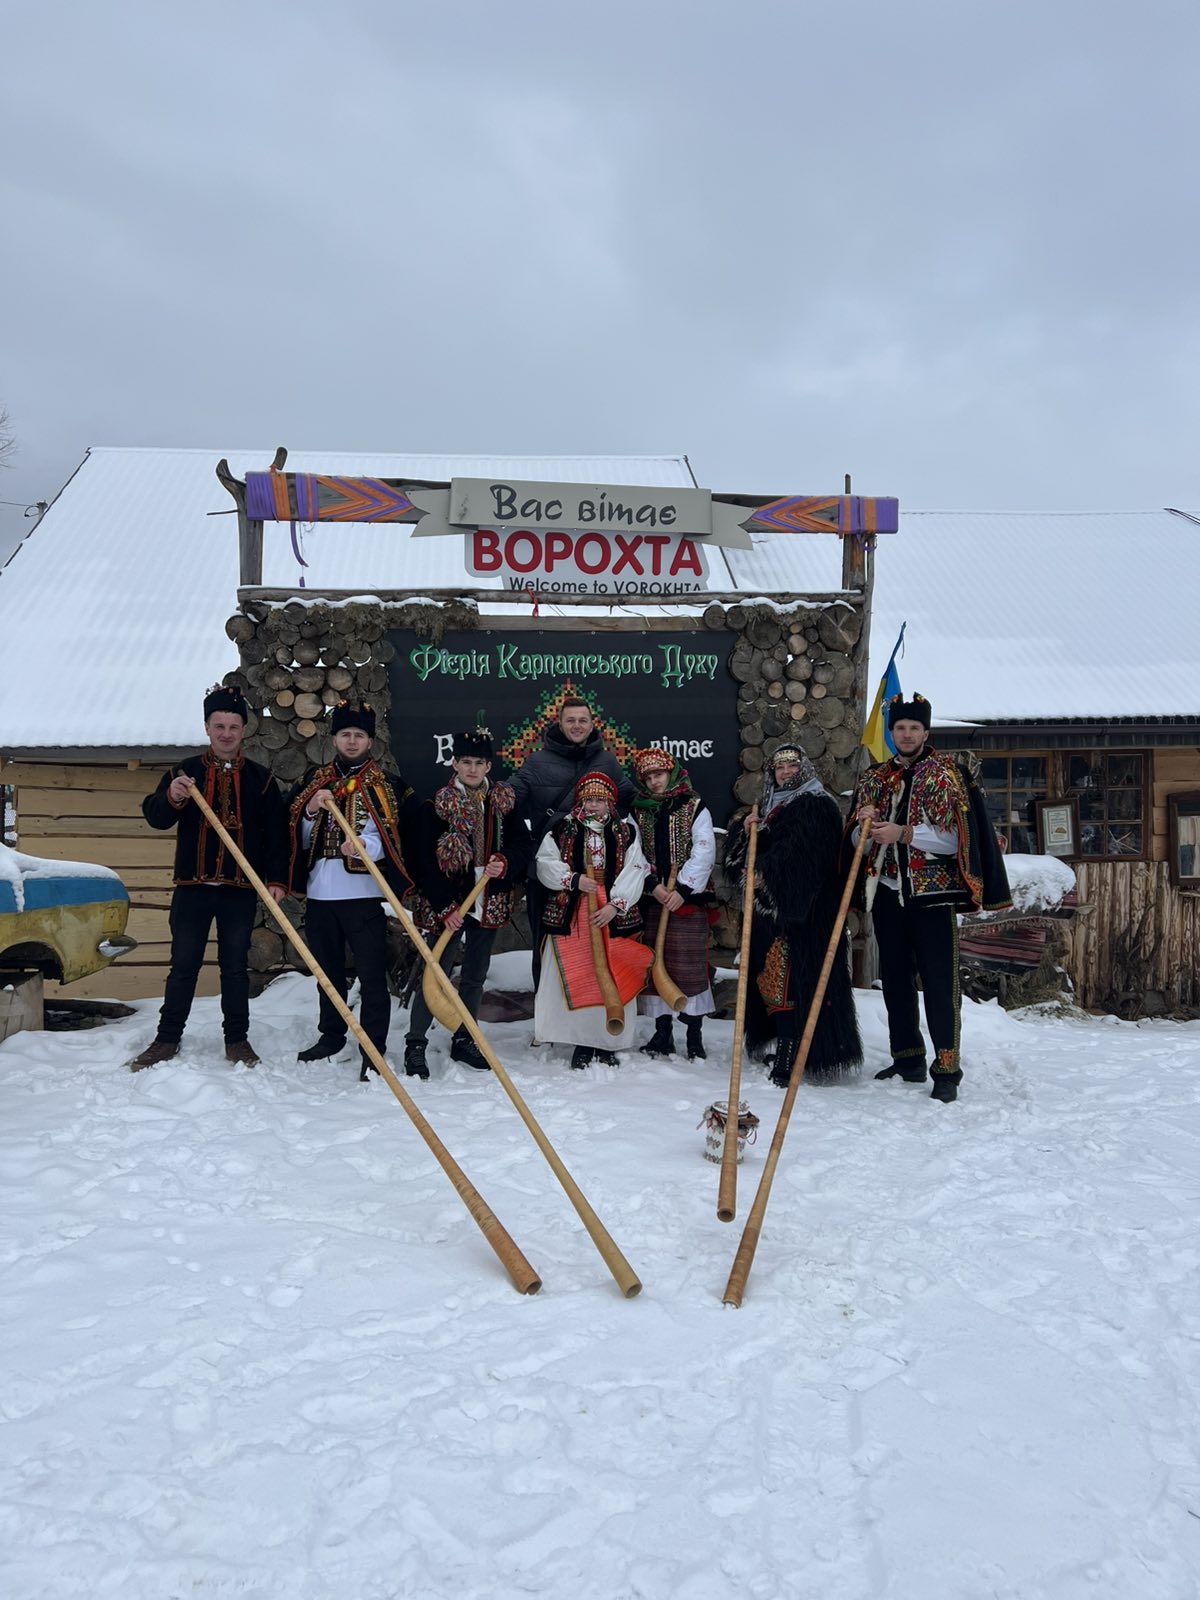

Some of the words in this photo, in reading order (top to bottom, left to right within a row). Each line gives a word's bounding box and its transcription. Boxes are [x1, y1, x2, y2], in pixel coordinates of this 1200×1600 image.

[489, 484, 563, 521] Вас
[578, 492, 677, 526] вітає
[472, 530, 703, 577] ВОРОХТА
[509, 577, 588, 594] Welcome
[593, 581, 608, 594] to
[614, 580, 701, 595] VOROKHTA
[409, 643, 491, 681] Фієрія
[496, 643, 653, 681] Карпатського
[657, 644, 719, 688] Духу
